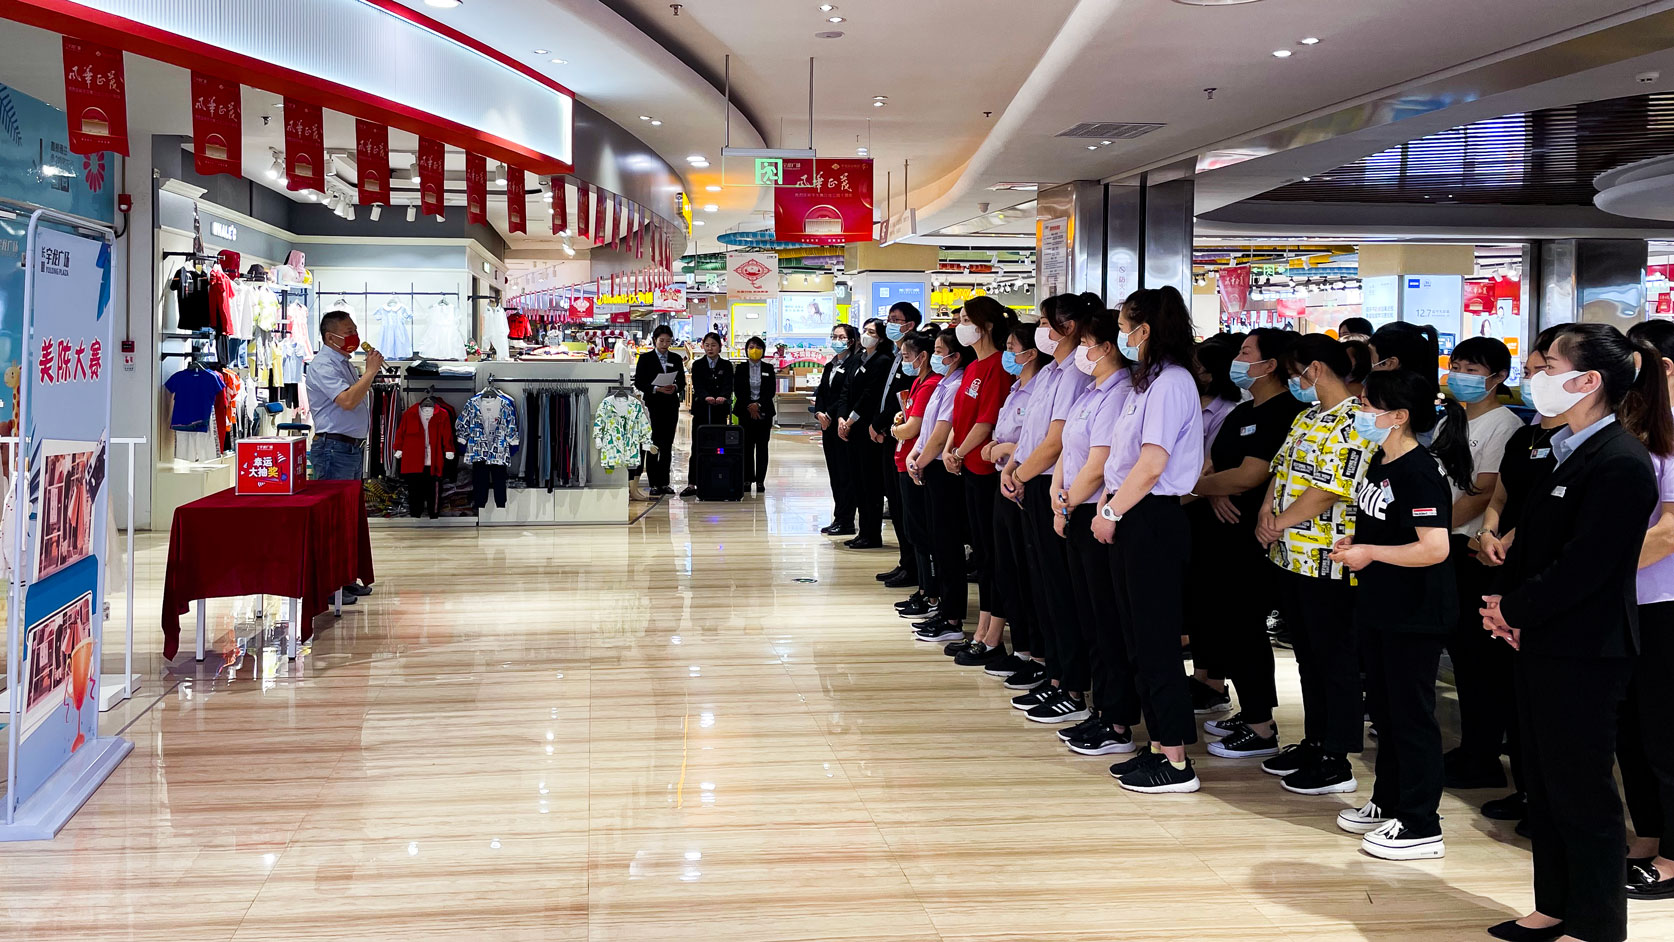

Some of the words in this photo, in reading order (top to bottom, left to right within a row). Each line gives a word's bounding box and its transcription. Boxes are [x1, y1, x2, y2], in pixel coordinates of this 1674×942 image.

[39, 337, 101, 384] 美陈大赛
[253, 457, 273, 467] 幸运
[248, 466, 278, 477] 大抽奖
